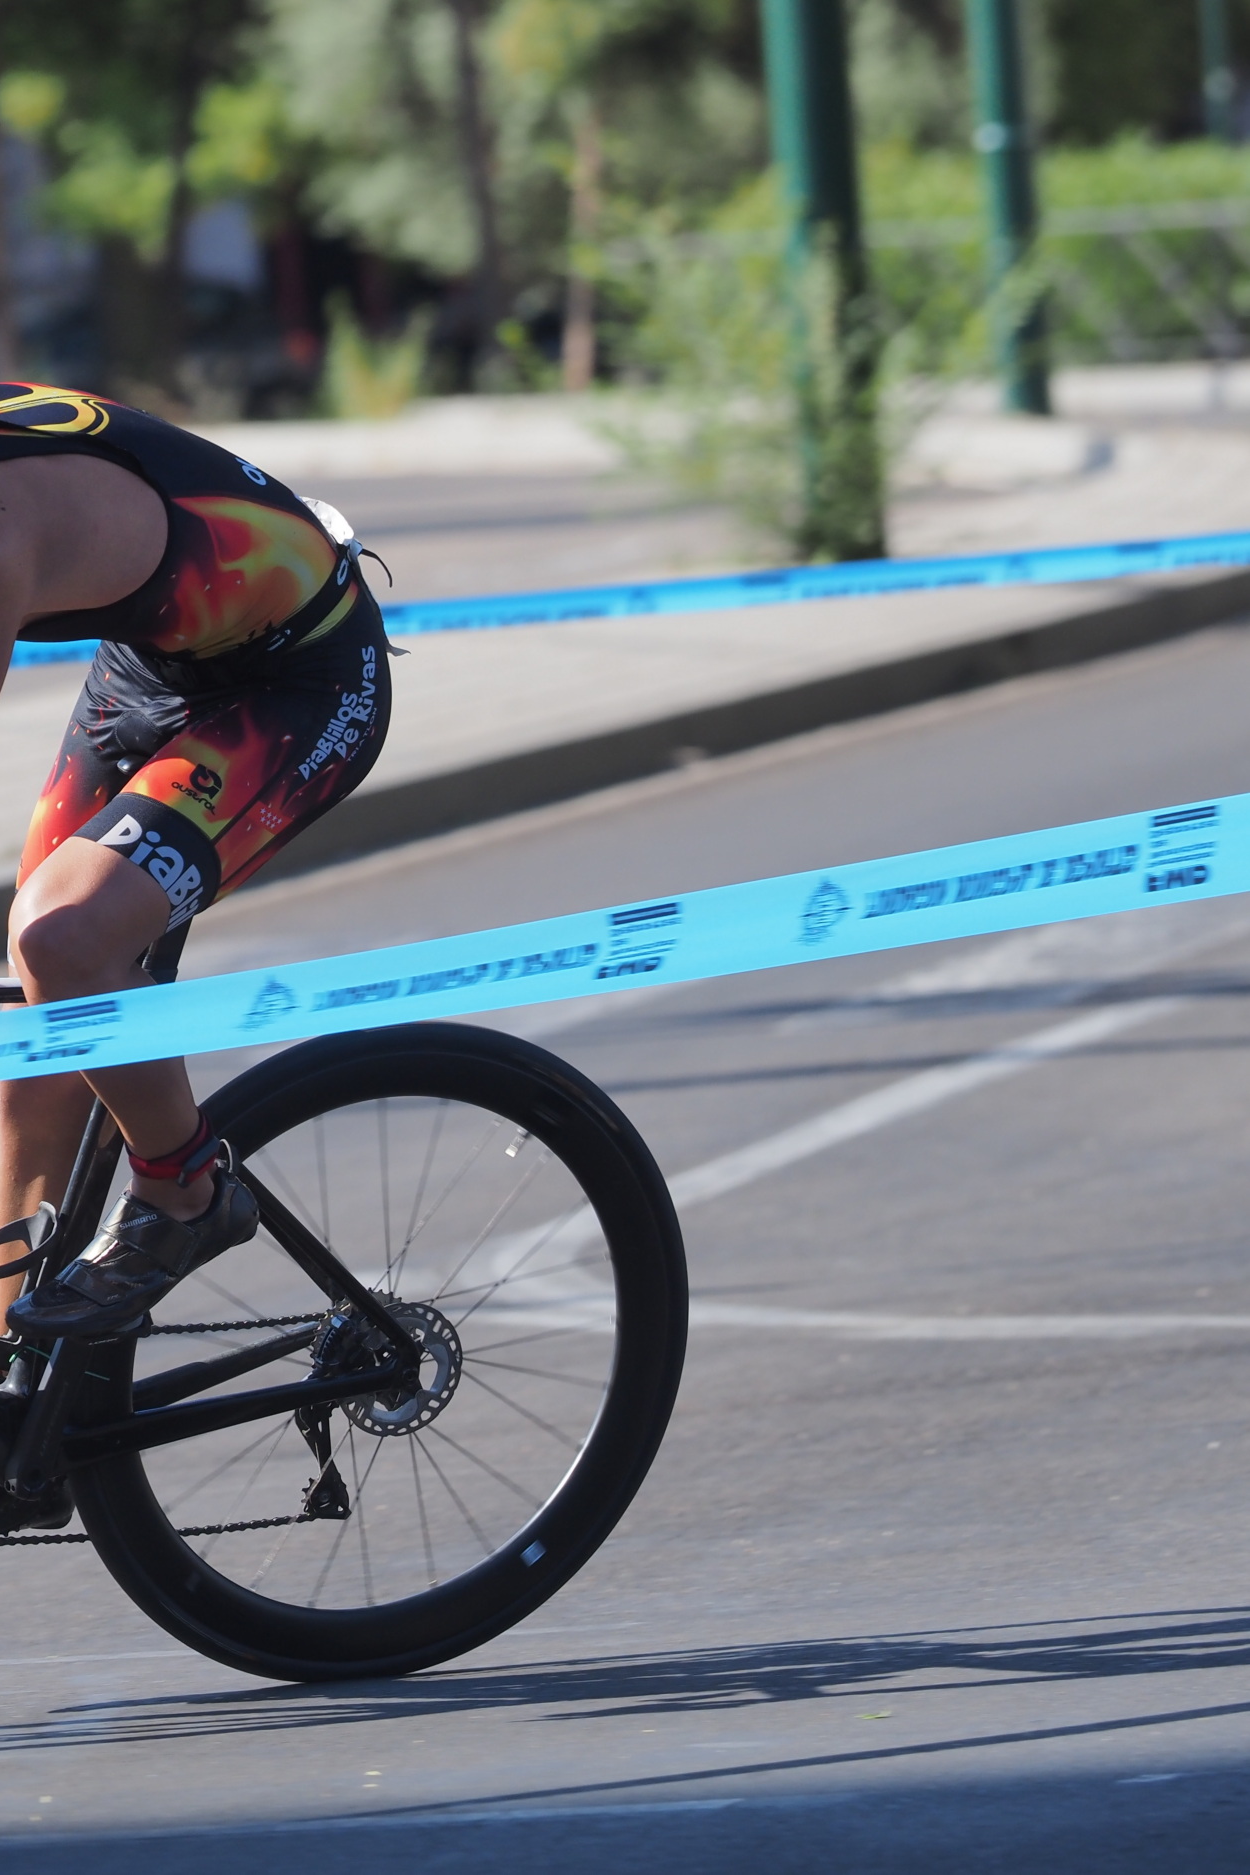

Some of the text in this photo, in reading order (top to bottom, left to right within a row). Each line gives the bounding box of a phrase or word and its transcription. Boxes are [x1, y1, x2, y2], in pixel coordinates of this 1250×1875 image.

[351, 645, 376, 722] Rivas
[347, 707, 377, 761] TRIATLON
[171, 781, 216, 816] austral
[120, 1213, 158, 1230] SHIMANO
